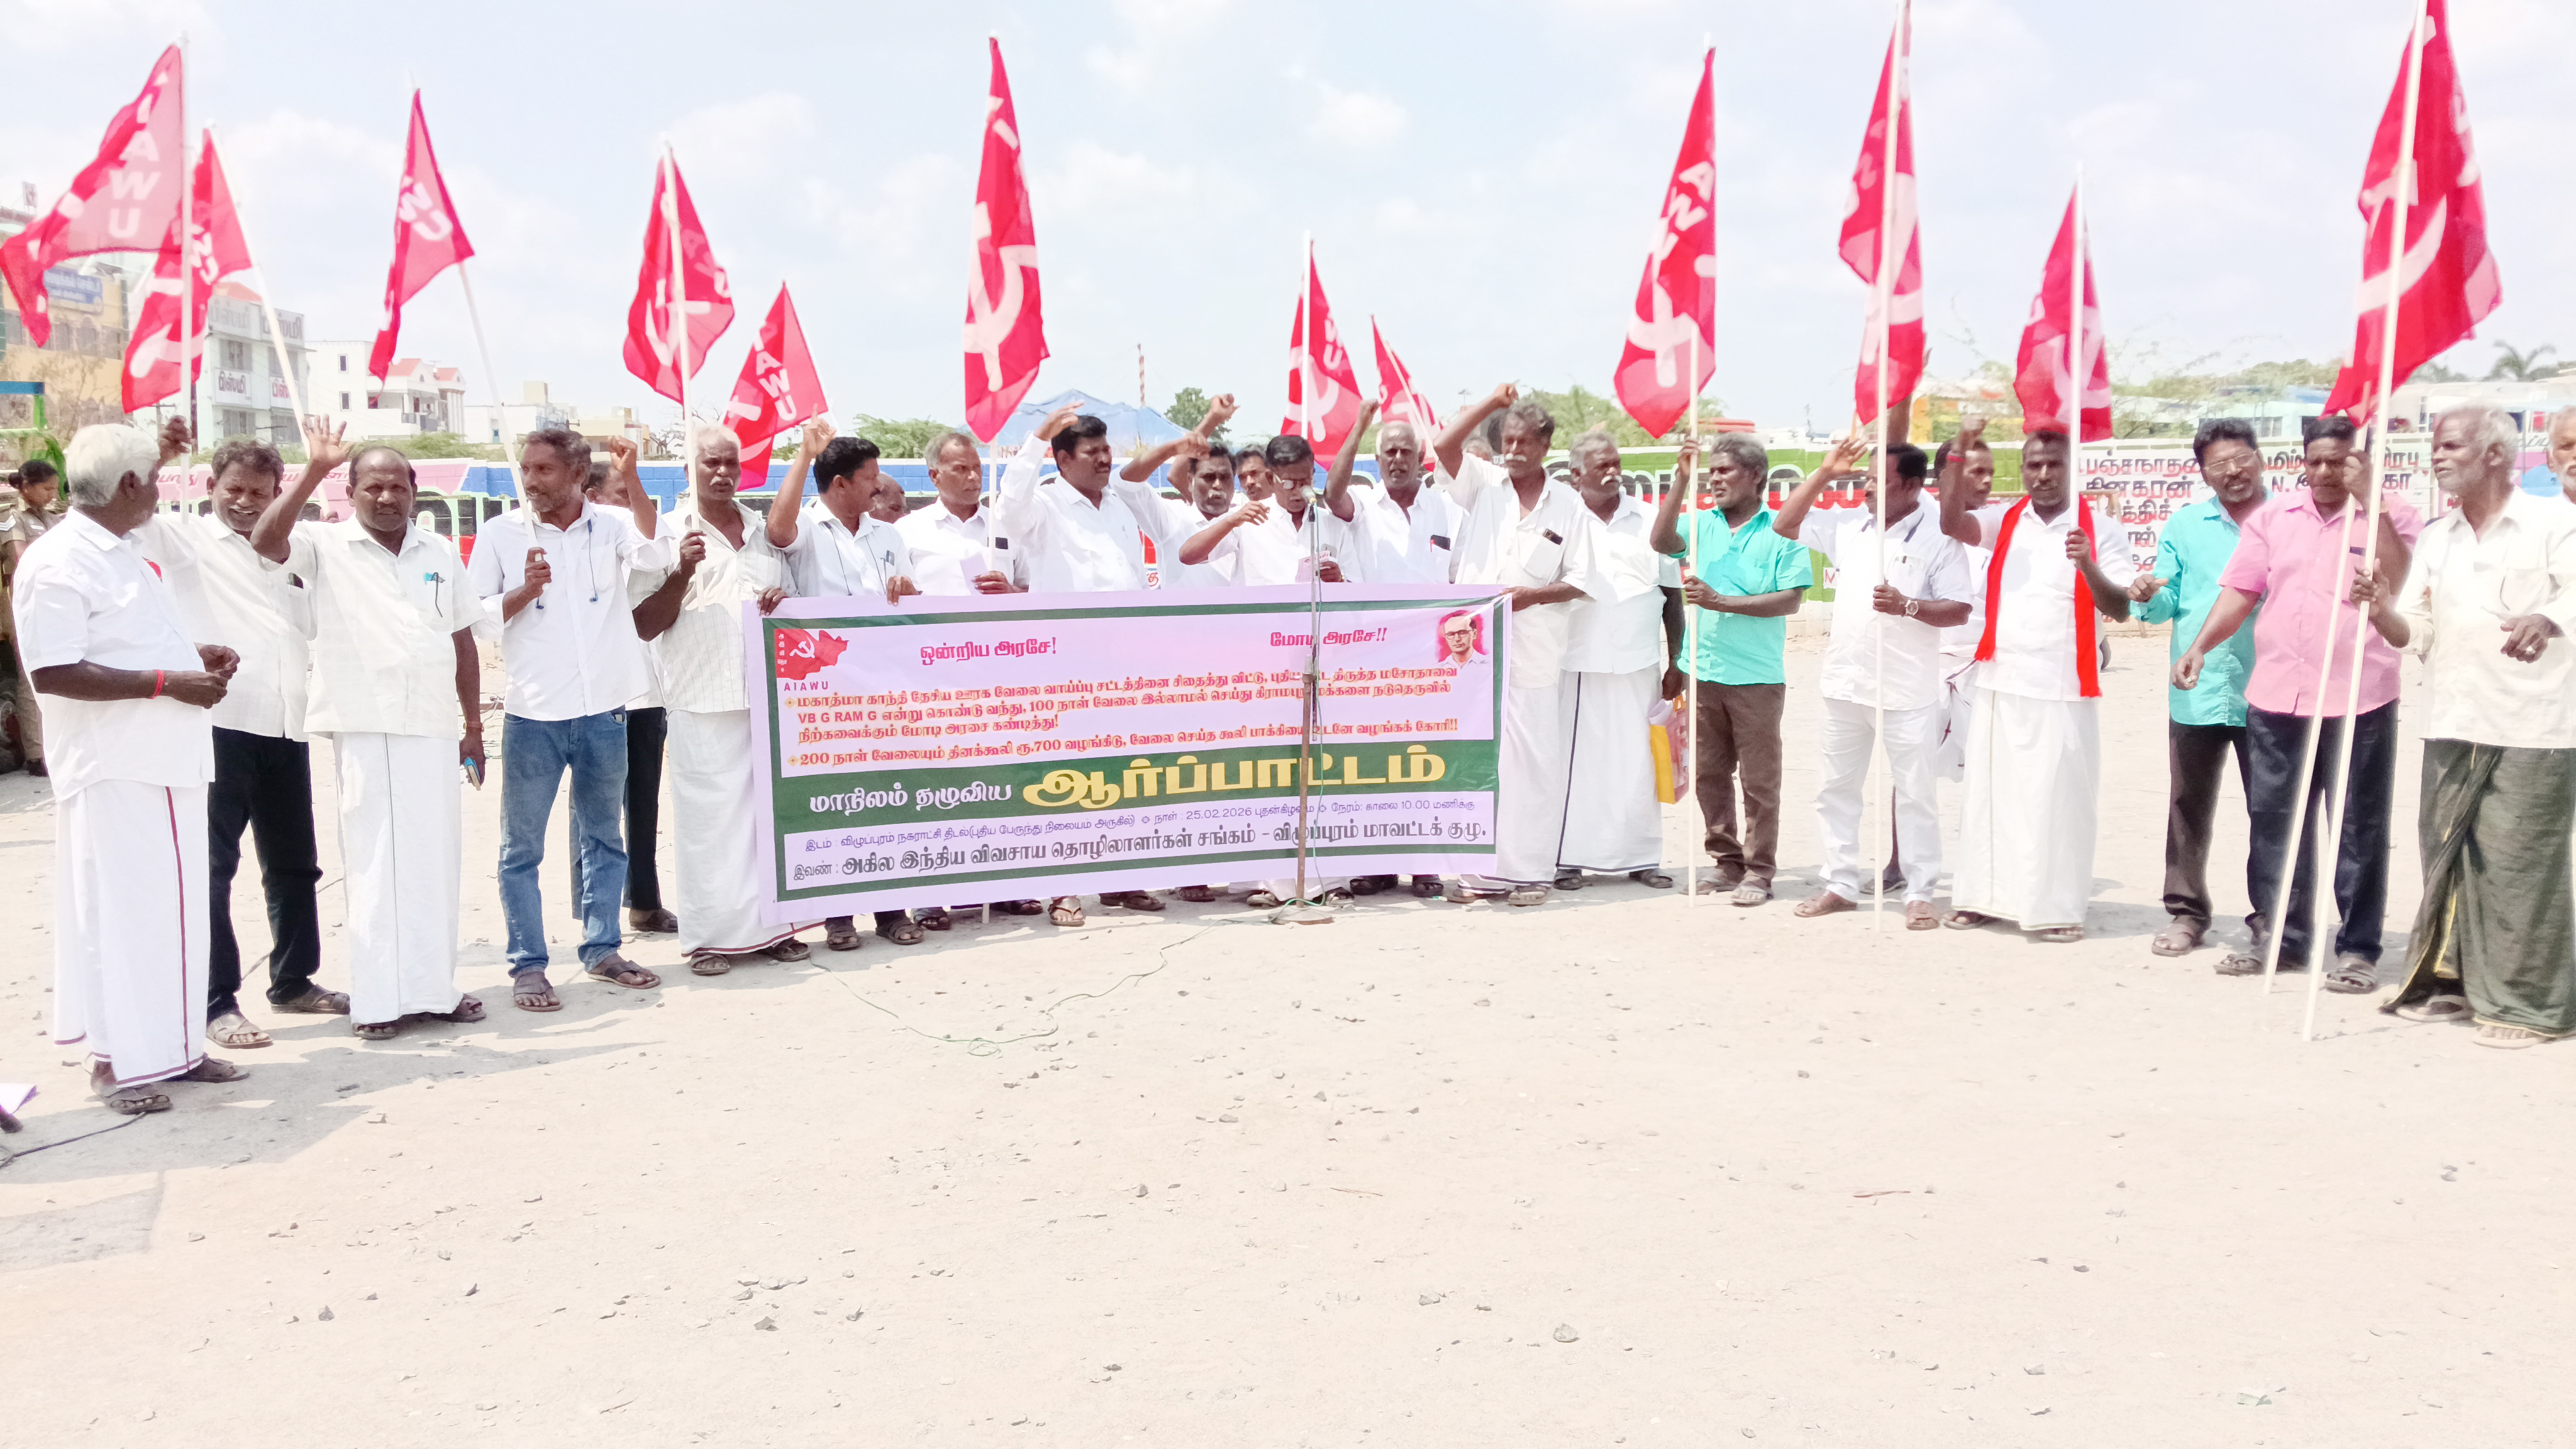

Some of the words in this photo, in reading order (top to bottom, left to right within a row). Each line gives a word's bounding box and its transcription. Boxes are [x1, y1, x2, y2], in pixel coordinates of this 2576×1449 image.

[920, 641, 990, 665] ஒன்றிய
[994, 636, 1057, 658] அரசே!
[1323, 628, 1387, 645] அரசே!!
[784, 681, 828, 691] AIAWU
[797, 692, 863, 708] மகாத்மா
[867, 691, 908, 707] காந்தி
[911, 689, 952, 704] தேசிய
[955, 689, 991, 700] ஊரக
[995, 686, 1041, 698] வேலை
[1044, 679, 1093, 694] வாய்ப்பு
[1097, 676, 1169, 692] சட்டத்தினை
[1173, 672, 1228, 688] சிதைத்து
[1231, 672, 1268, 684] விட்டு,
[1333, 667, 1377, 682] திருத்த
[1380, 667, 1457, 681] மசோதாவை
[882, 707, 923, 723] என்று
[926, 702, 983, 718] கொண்டு
[987, 701, 1026, 718] வந்து,
[1029, 700, 1054, 713] 100
[1057, 696, 1089, 713] நாள்
[1093, 696, 1138, 708] வேலை
[1141, 689, 1208, 705] இல்லாமல்
[1211, 687, 1252, 702] செய்து
[1372, 680, 1451, 697] நடுதெருவில்
[798, 713, 816, 723] VB
[821, 713, 830, 723] G
[835, 711, 863, 722] RAM
[867, 711, 877, 721] G
[798, 724, 898, 745] நிற்கவைக்கும்
[901, 725, 941, 738] மோடி
[945, 723, 989, 735] அரசை
[992, 714, 1058, 731] கண்டித்து!
[800, 753, 830, 765] 200
[833, 748, 868, 767] நாள்
[872, 745, 945, 761] வேலையும்
[948, 741, 1013, 761] தினக்கூலி
[1016, 740, 1061, 755] ரூ.700
[1130, 733, 1174, 745] வேலை
[1177, 728, 1216, 745] செய்த
[1219, 725, 1247, 739] கூலி
[1357, 719, 1413, 736] வழங்கக்
[809, 782, 908, 816] மாநிலம்
[915, 780, 1012, 811] தழுவிய
[1023, 744, 1446, 809] ஆர்ப்பாட்டம்
[1154, 811, 1178, 825] நாள்
[1365, 802, 1398, 811] காலை
[1401, 800, 1430, 809] 10.00
[1433, 798, 1475, 811] மணிக்கு
[793, 860, 833, 880] இவண்
[841, 852, 895, 875] அகில
[899, 844, 965, 874] இந்திய
[970, 843, 1046, 864] விவசாய
[1051, 828, 1192, 860] தொழிலாளர்கள்
[1197, 823, 1256, 847] சங்கம்
[1363, 816, 1443, 838] மாவட்டக்
[805, 837, 832, 852] இடம்
[841, 832, 895, 848] விழுப்புரம்
[897, 828, 941, 845] நகராட்சி
[999, 822, 1042, 836] பேருந்து
[1045, 818, 1092, 835] நிலையம்
